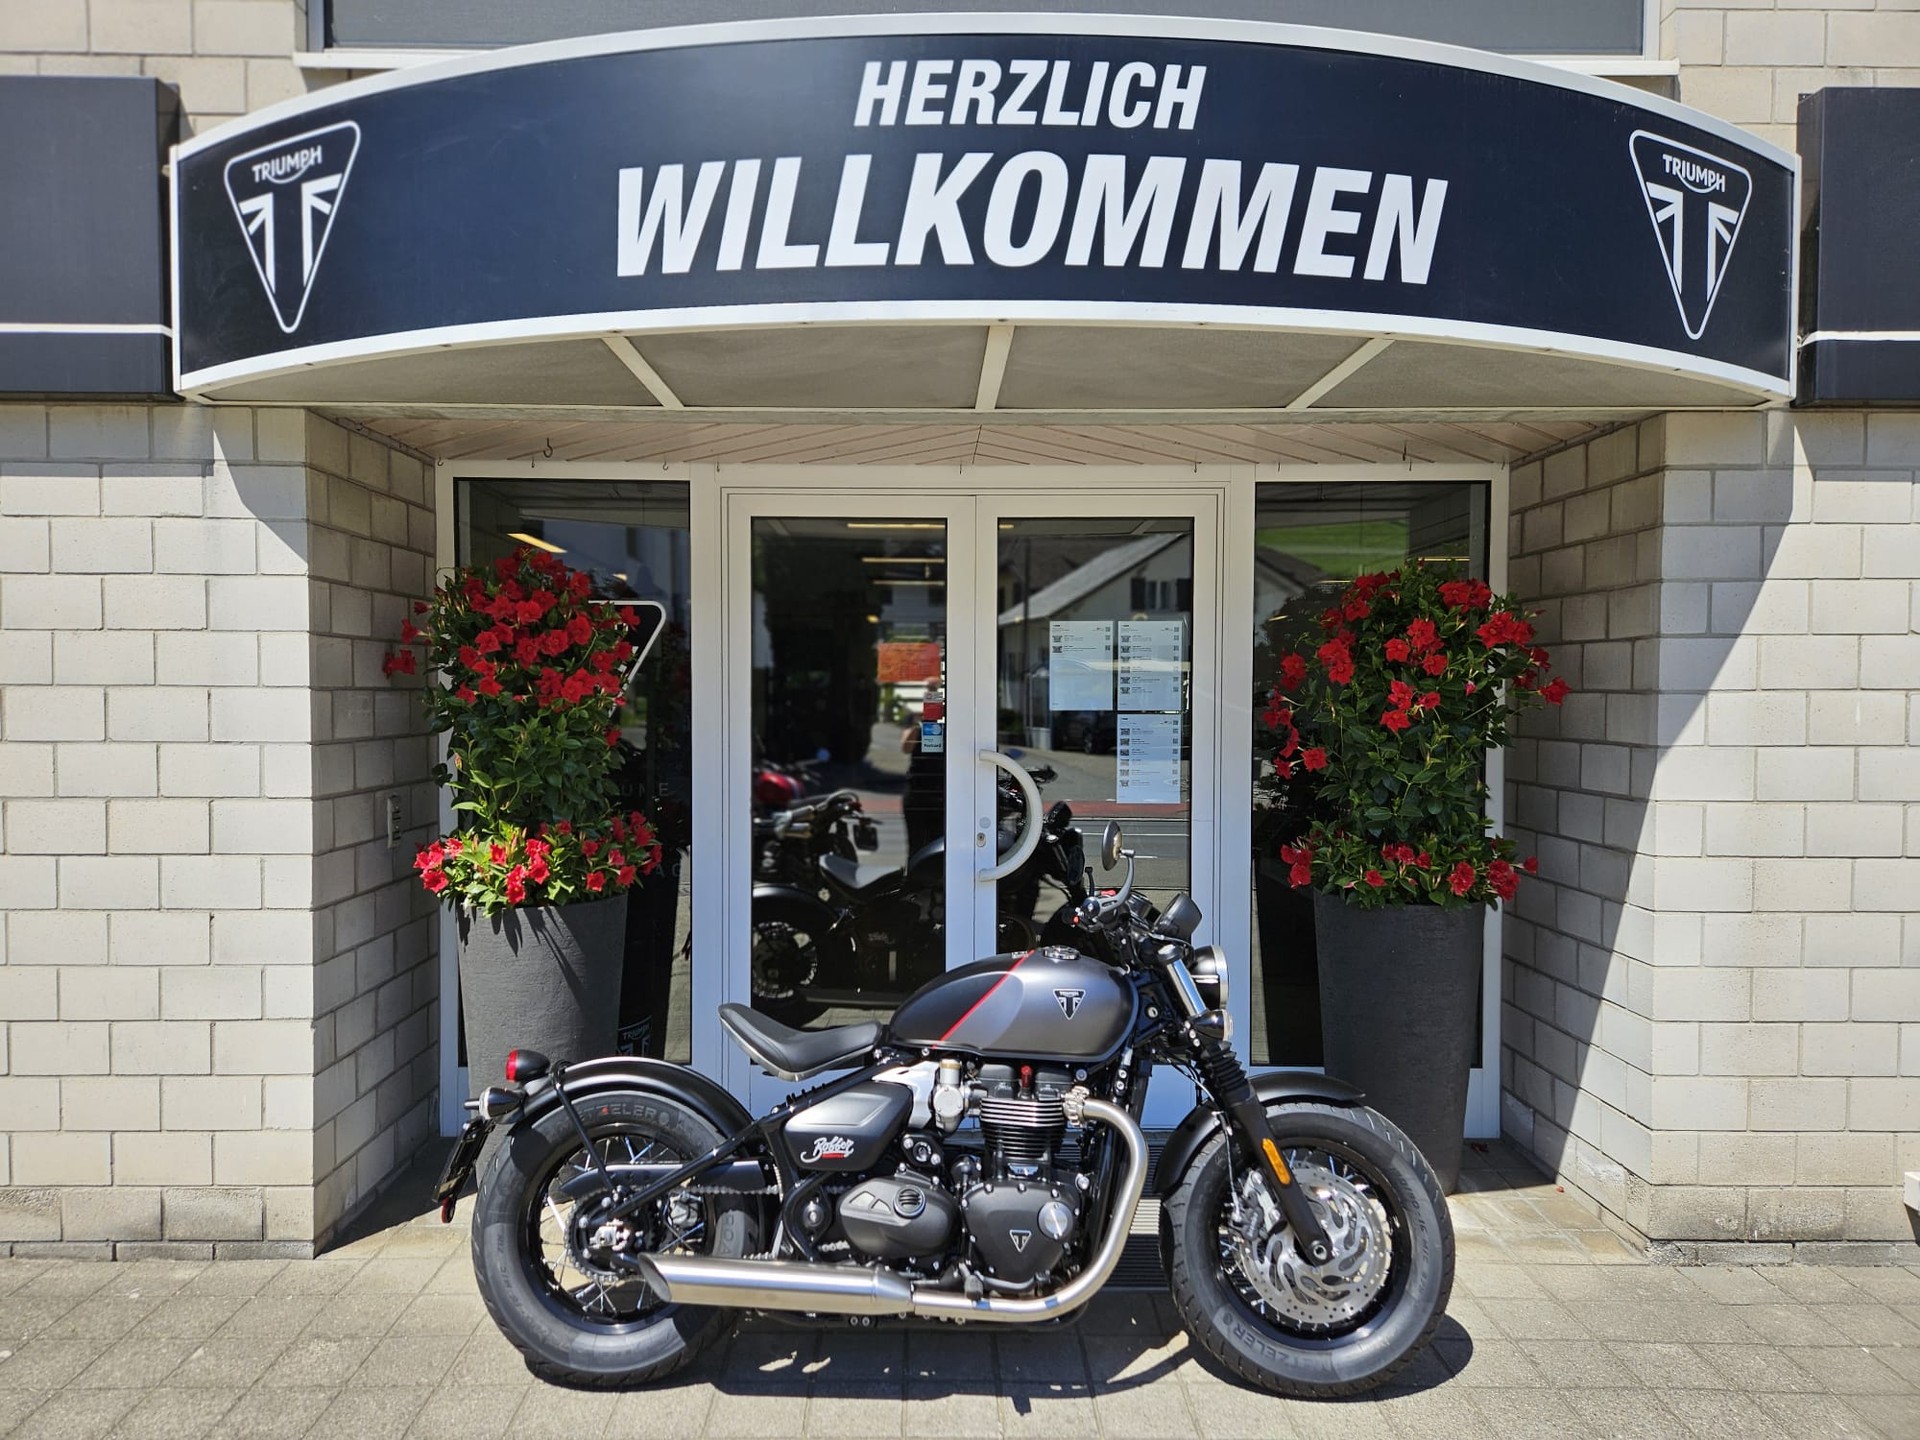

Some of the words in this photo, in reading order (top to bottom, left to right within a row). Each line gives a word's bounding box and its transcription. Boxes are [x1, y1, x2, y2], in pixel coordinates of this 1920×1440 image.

[854, 60, 1206, 129] HERZLICH
[252, 145, 322, 184] TRIUMPH
[1662, 153, 1726, 194] TRIUMPH
[616, 151, 1449, 284] WILLKOMMEN
[800, 1136, 855, 1163] Bobber
